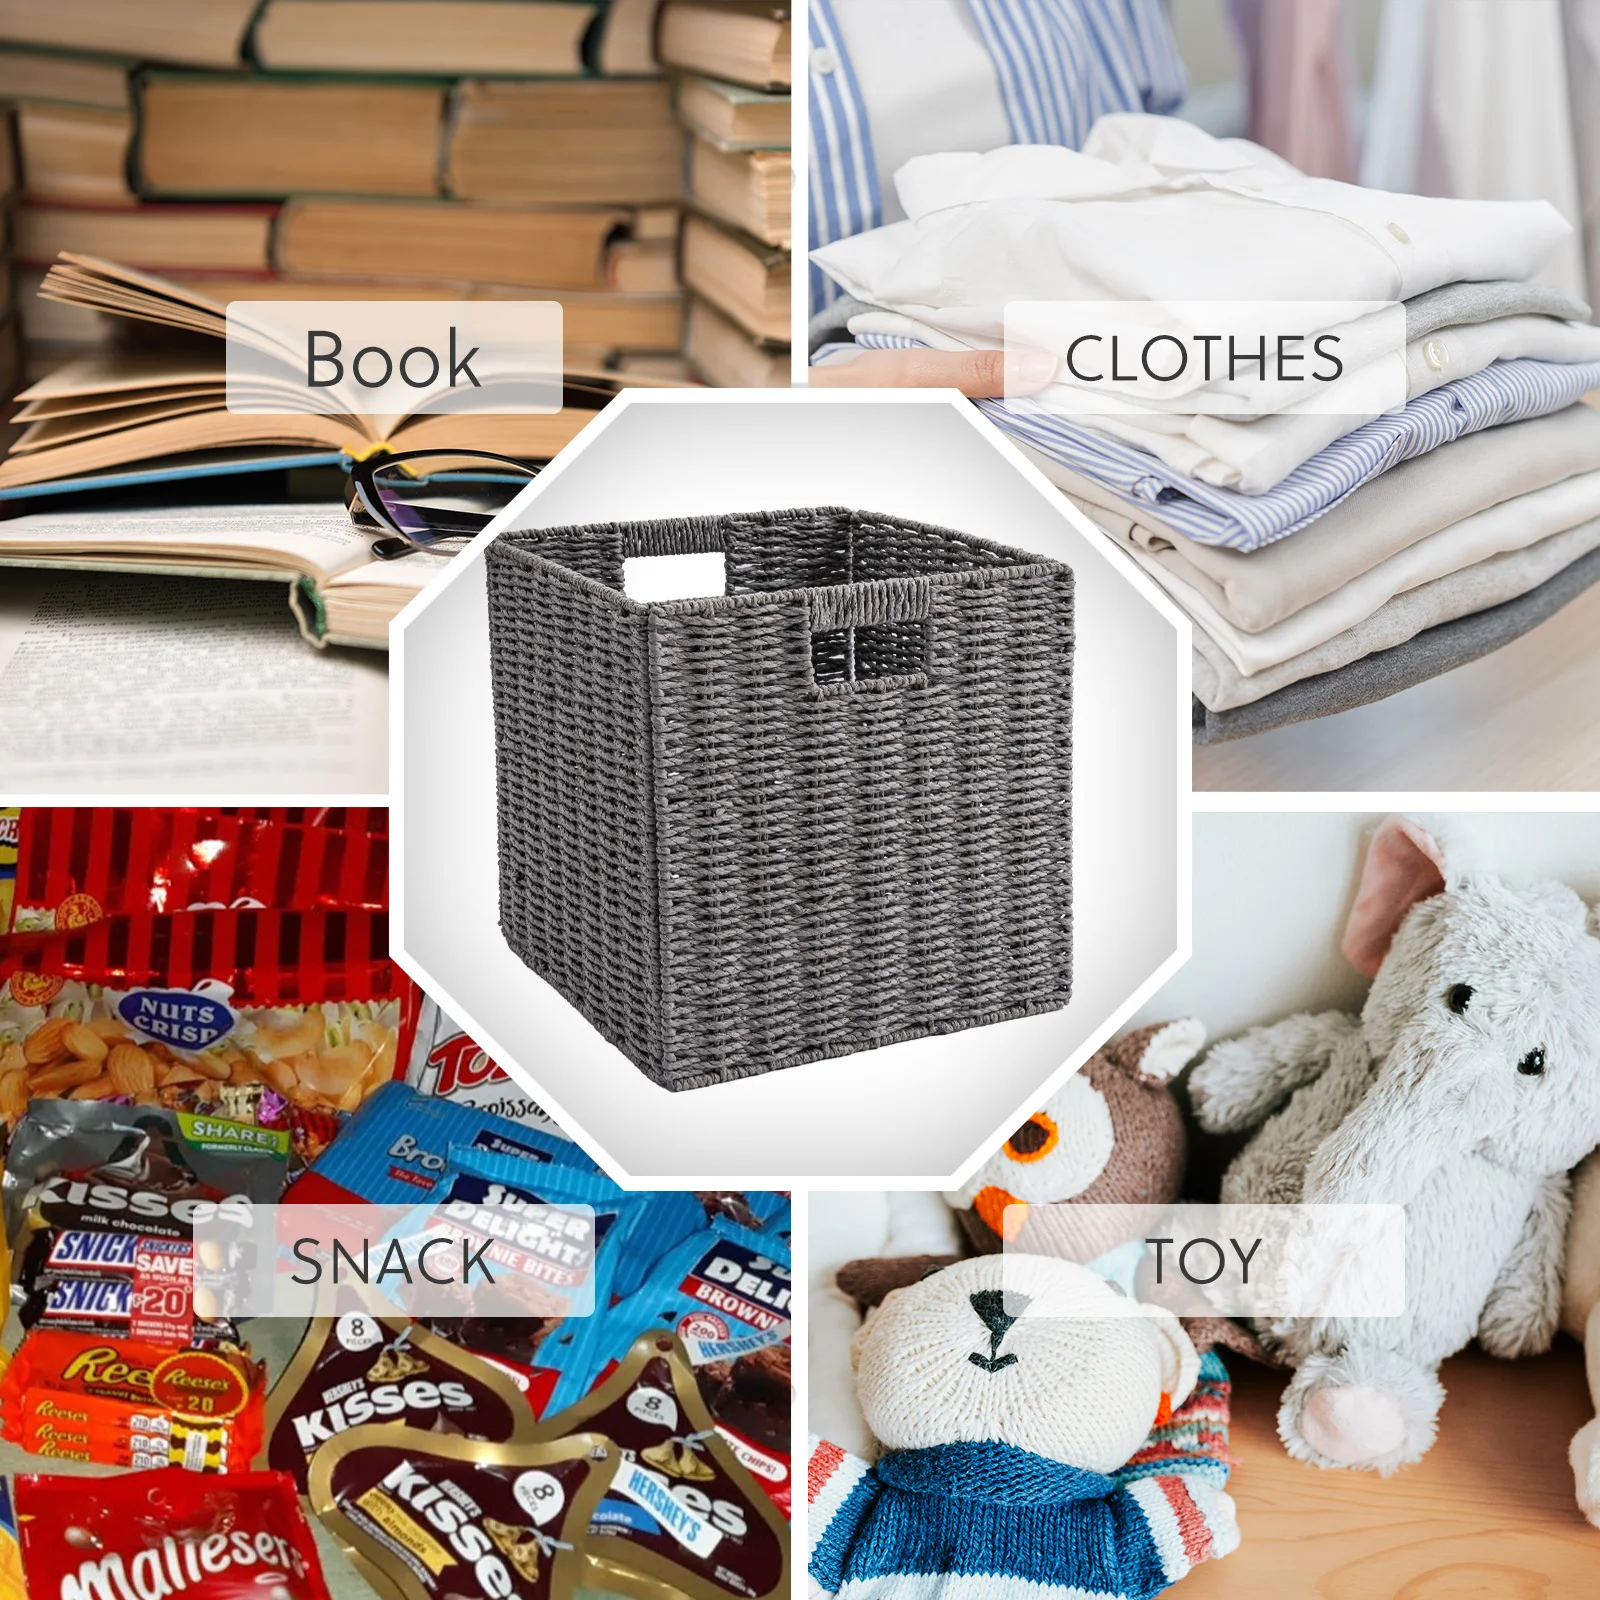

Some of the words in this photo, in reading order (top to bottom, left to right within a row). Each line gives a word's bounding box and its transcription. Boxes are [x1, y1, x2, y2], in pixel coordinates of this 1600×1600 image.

[140, 996, 215, 1023] NUTS
[133, 1015, 218, 1043] CRISP
[387, 1133, 446, 1171] Bro
[80, 1213, 109, 1226] milk
[111, 1219, 181, 1238] chocolate
[482, 1184, 591, 1242] SUPER
[55, 1230, 137, 1264] SNICK
[135, 1254, 194, 1276] SAVE
[523, 1257, 577, 1287] BITES
[50, 1281, 132, 1312] SNICK
[704, 1257, 791, 1312] DELI
[351, 1318, 364, 1337] 8
[698, 1329, 778, 1359] HERSHEY'S
[63, 1346, 153, 1388] Ree
[162, 1368, 230, 1391] Reese's
[35, 1400, 89, 1422] Reese's
[187, 1395, 214, 1413] 20
[644, 1397, 662, 1411] 8
[35, 1423, 89, 1445] Reese's
[38, 1440, 90, 1462] Reese's
[741, 1451, 777, 1474] CHIPS!
[532, 1483, 555, 1501] 8
[592, 1510, 633, 1524] colate
[628, 1469, 702, 1543] HERSHEY'S
